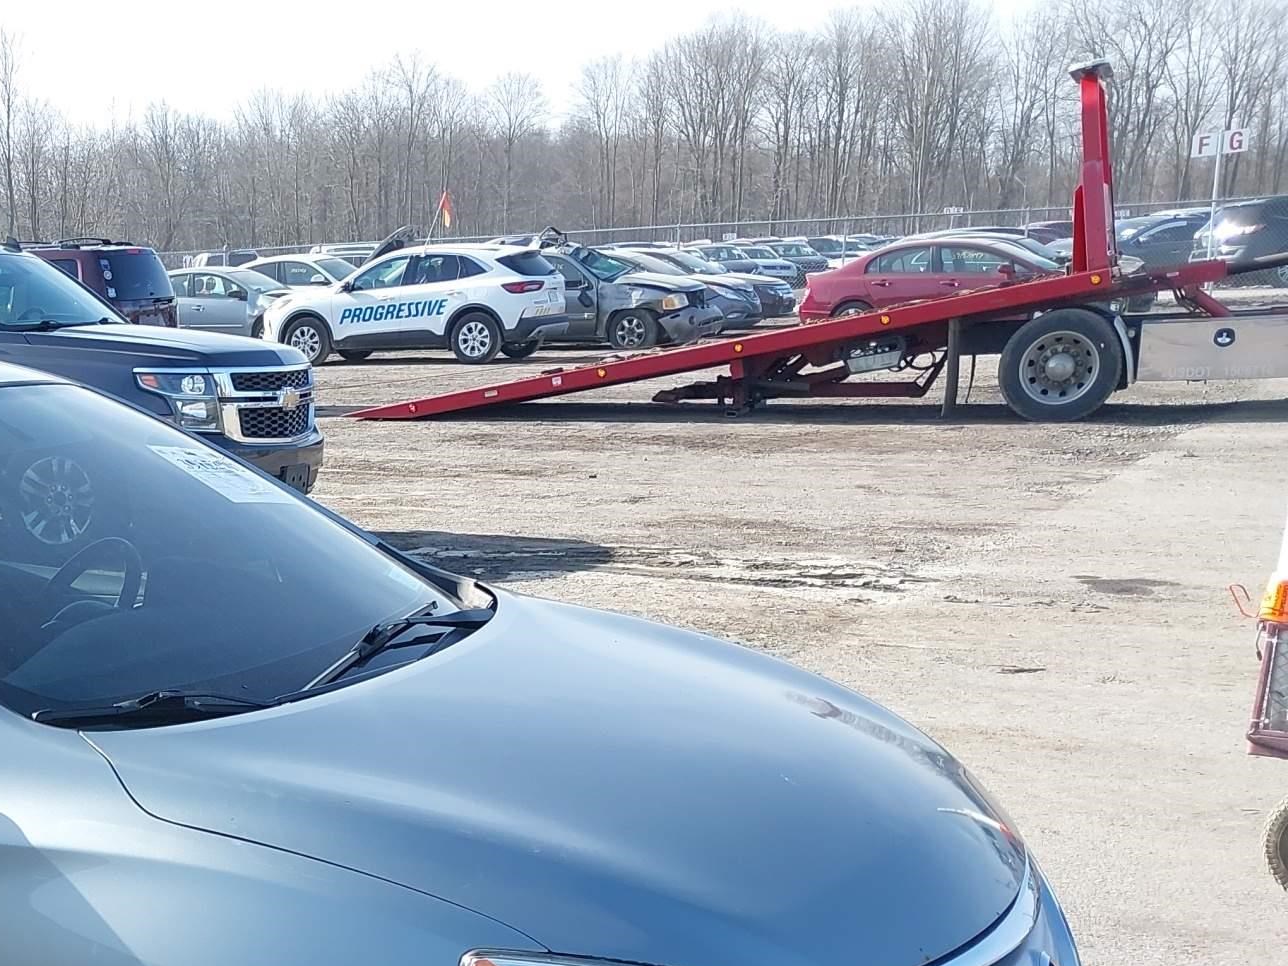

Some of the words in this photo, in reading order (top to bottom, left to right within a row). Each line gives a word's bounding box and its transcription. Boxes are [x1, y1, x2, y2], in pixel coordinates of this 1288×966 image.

[1198, 136, 1210, 154] F
[1229, 131, 1243, 150] G
[339, 299, 448, 326] PROGRESSIVE
